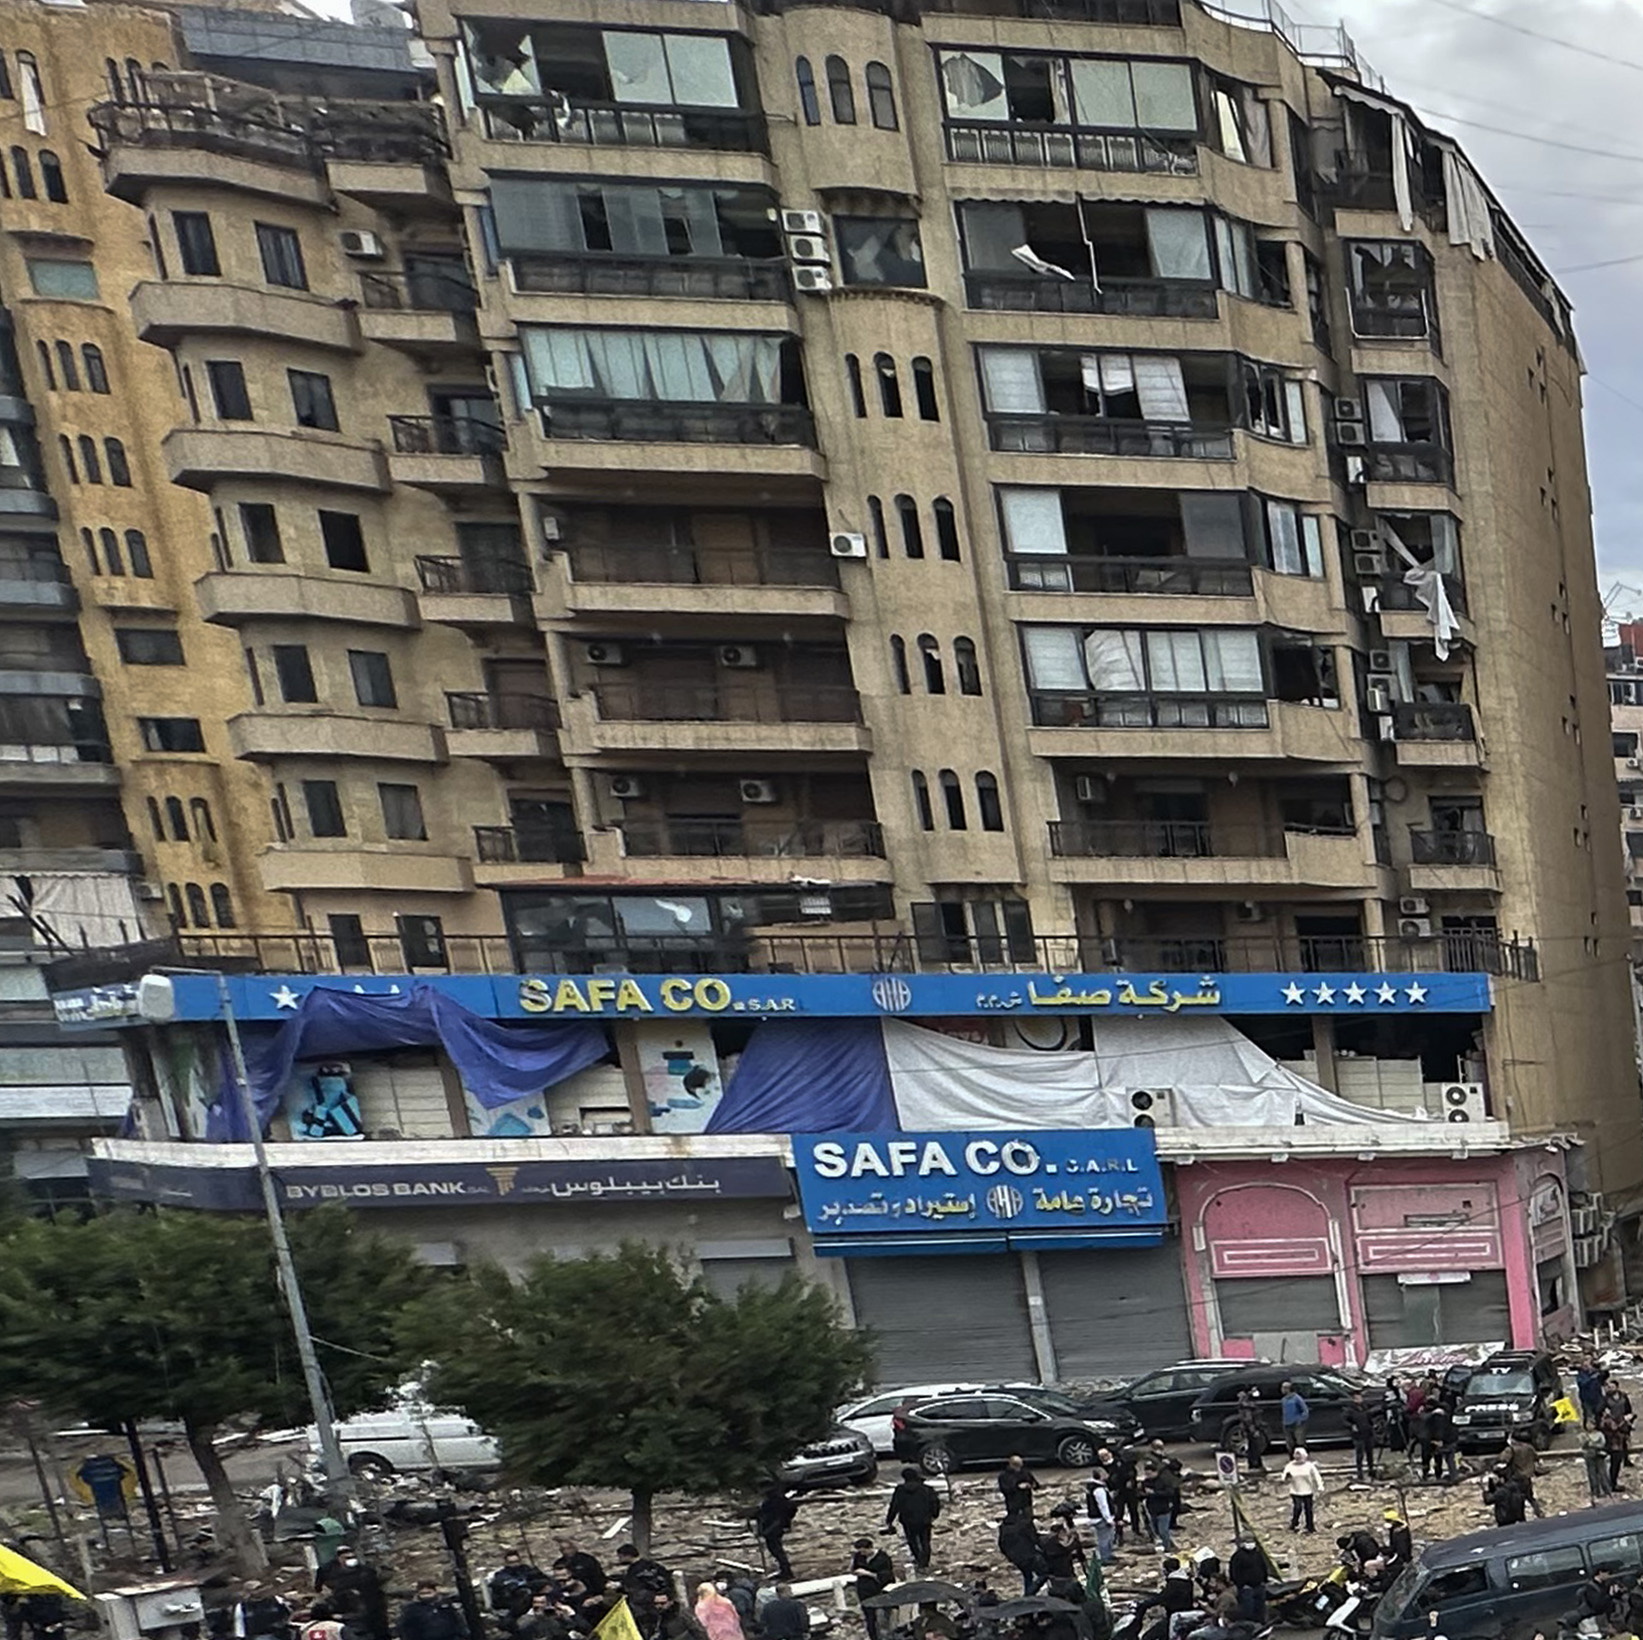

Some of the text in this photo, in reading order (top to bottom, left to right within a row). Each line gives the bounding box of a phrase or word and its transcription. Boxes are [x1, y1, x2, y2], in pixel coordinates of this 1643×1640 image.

[519, 978, 653, 1013] SAFA
[1026, 975, 1112, 1006] صفا
[1118, 975, 1221, 1013] شركة
[813, 1141, 958, 1179] SAFA
[286, 1183, 390, 1199] BYBLOS
[393, 1180, 466, 1197] BANK
[552, 1175, 664, 1199] بيبلوس
[666, 1174, 720, 1192] بنك
[1091, 1186, 1154, 1217] تجارة
[1490, 1366, 1511, 1375] TV
